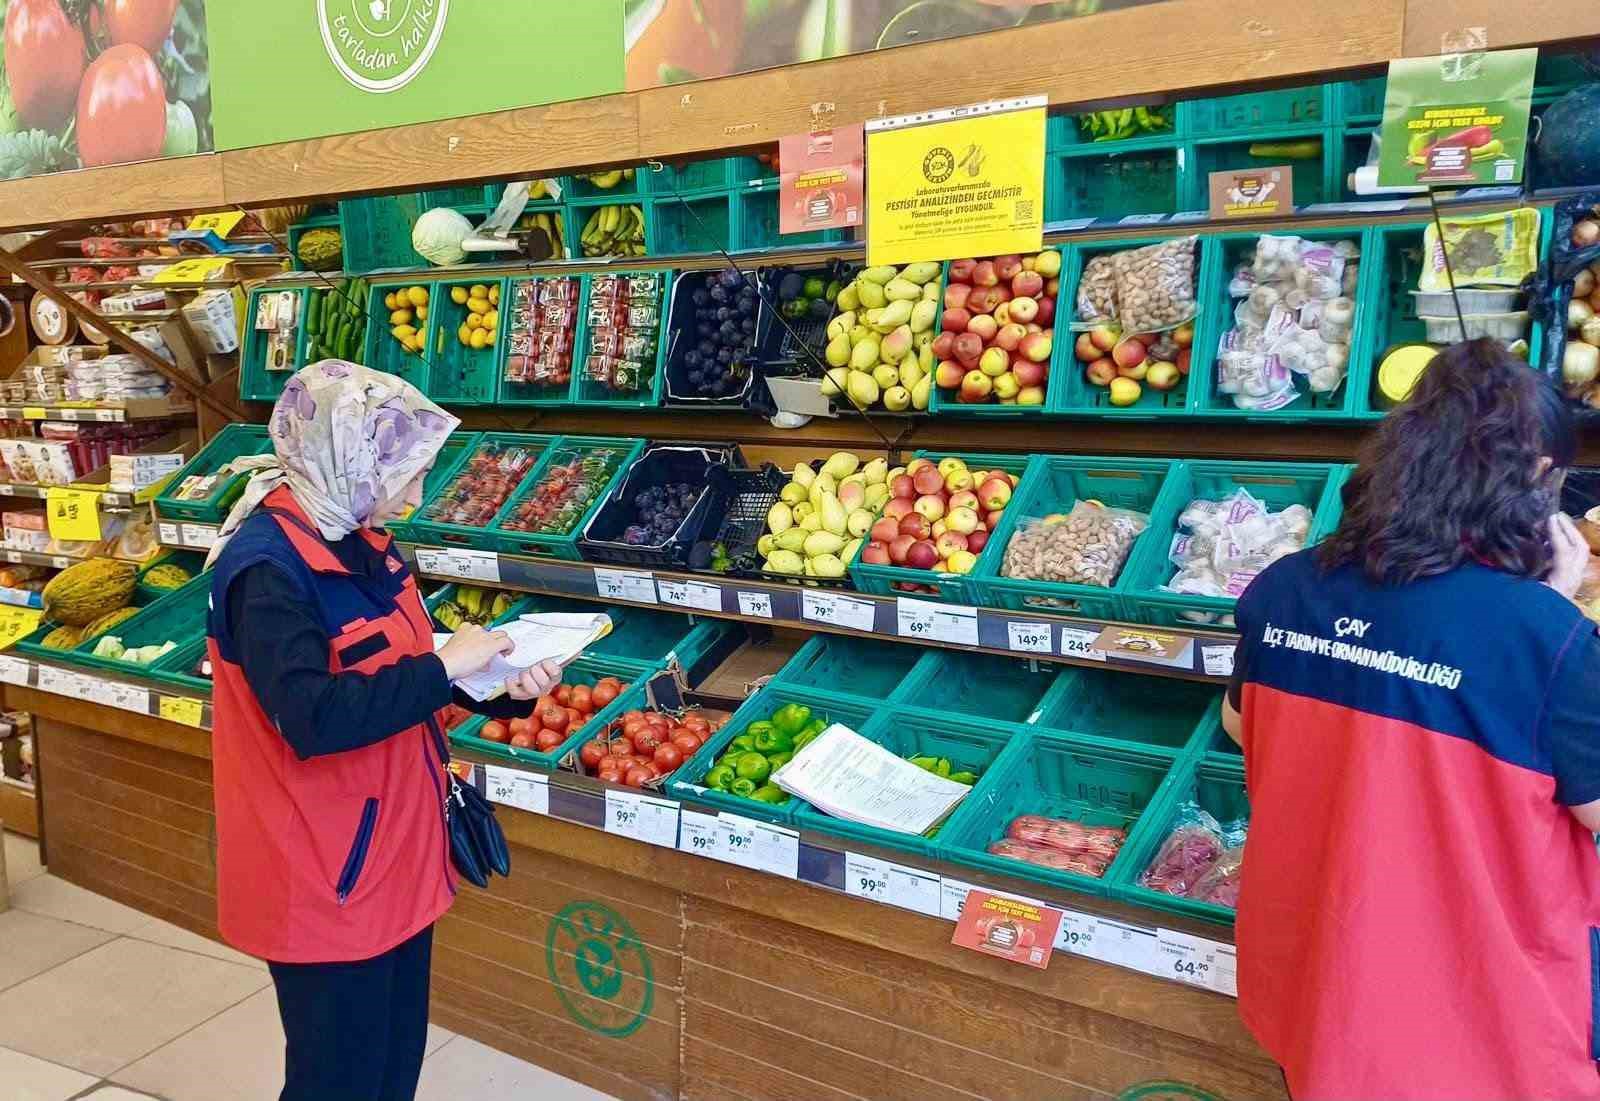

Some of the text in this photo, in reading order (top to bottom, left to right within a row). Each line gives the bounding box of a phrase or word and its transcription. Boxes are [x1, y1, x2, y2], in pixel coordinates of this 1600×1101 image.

[333, 12, 398, 70] tarladan
[1262, 622, 1463, 690] İLÇE TARIM VE ORMAN MÜDÜRLÜĞÜ
[1334, 616, 1372, 638] ÇAY
